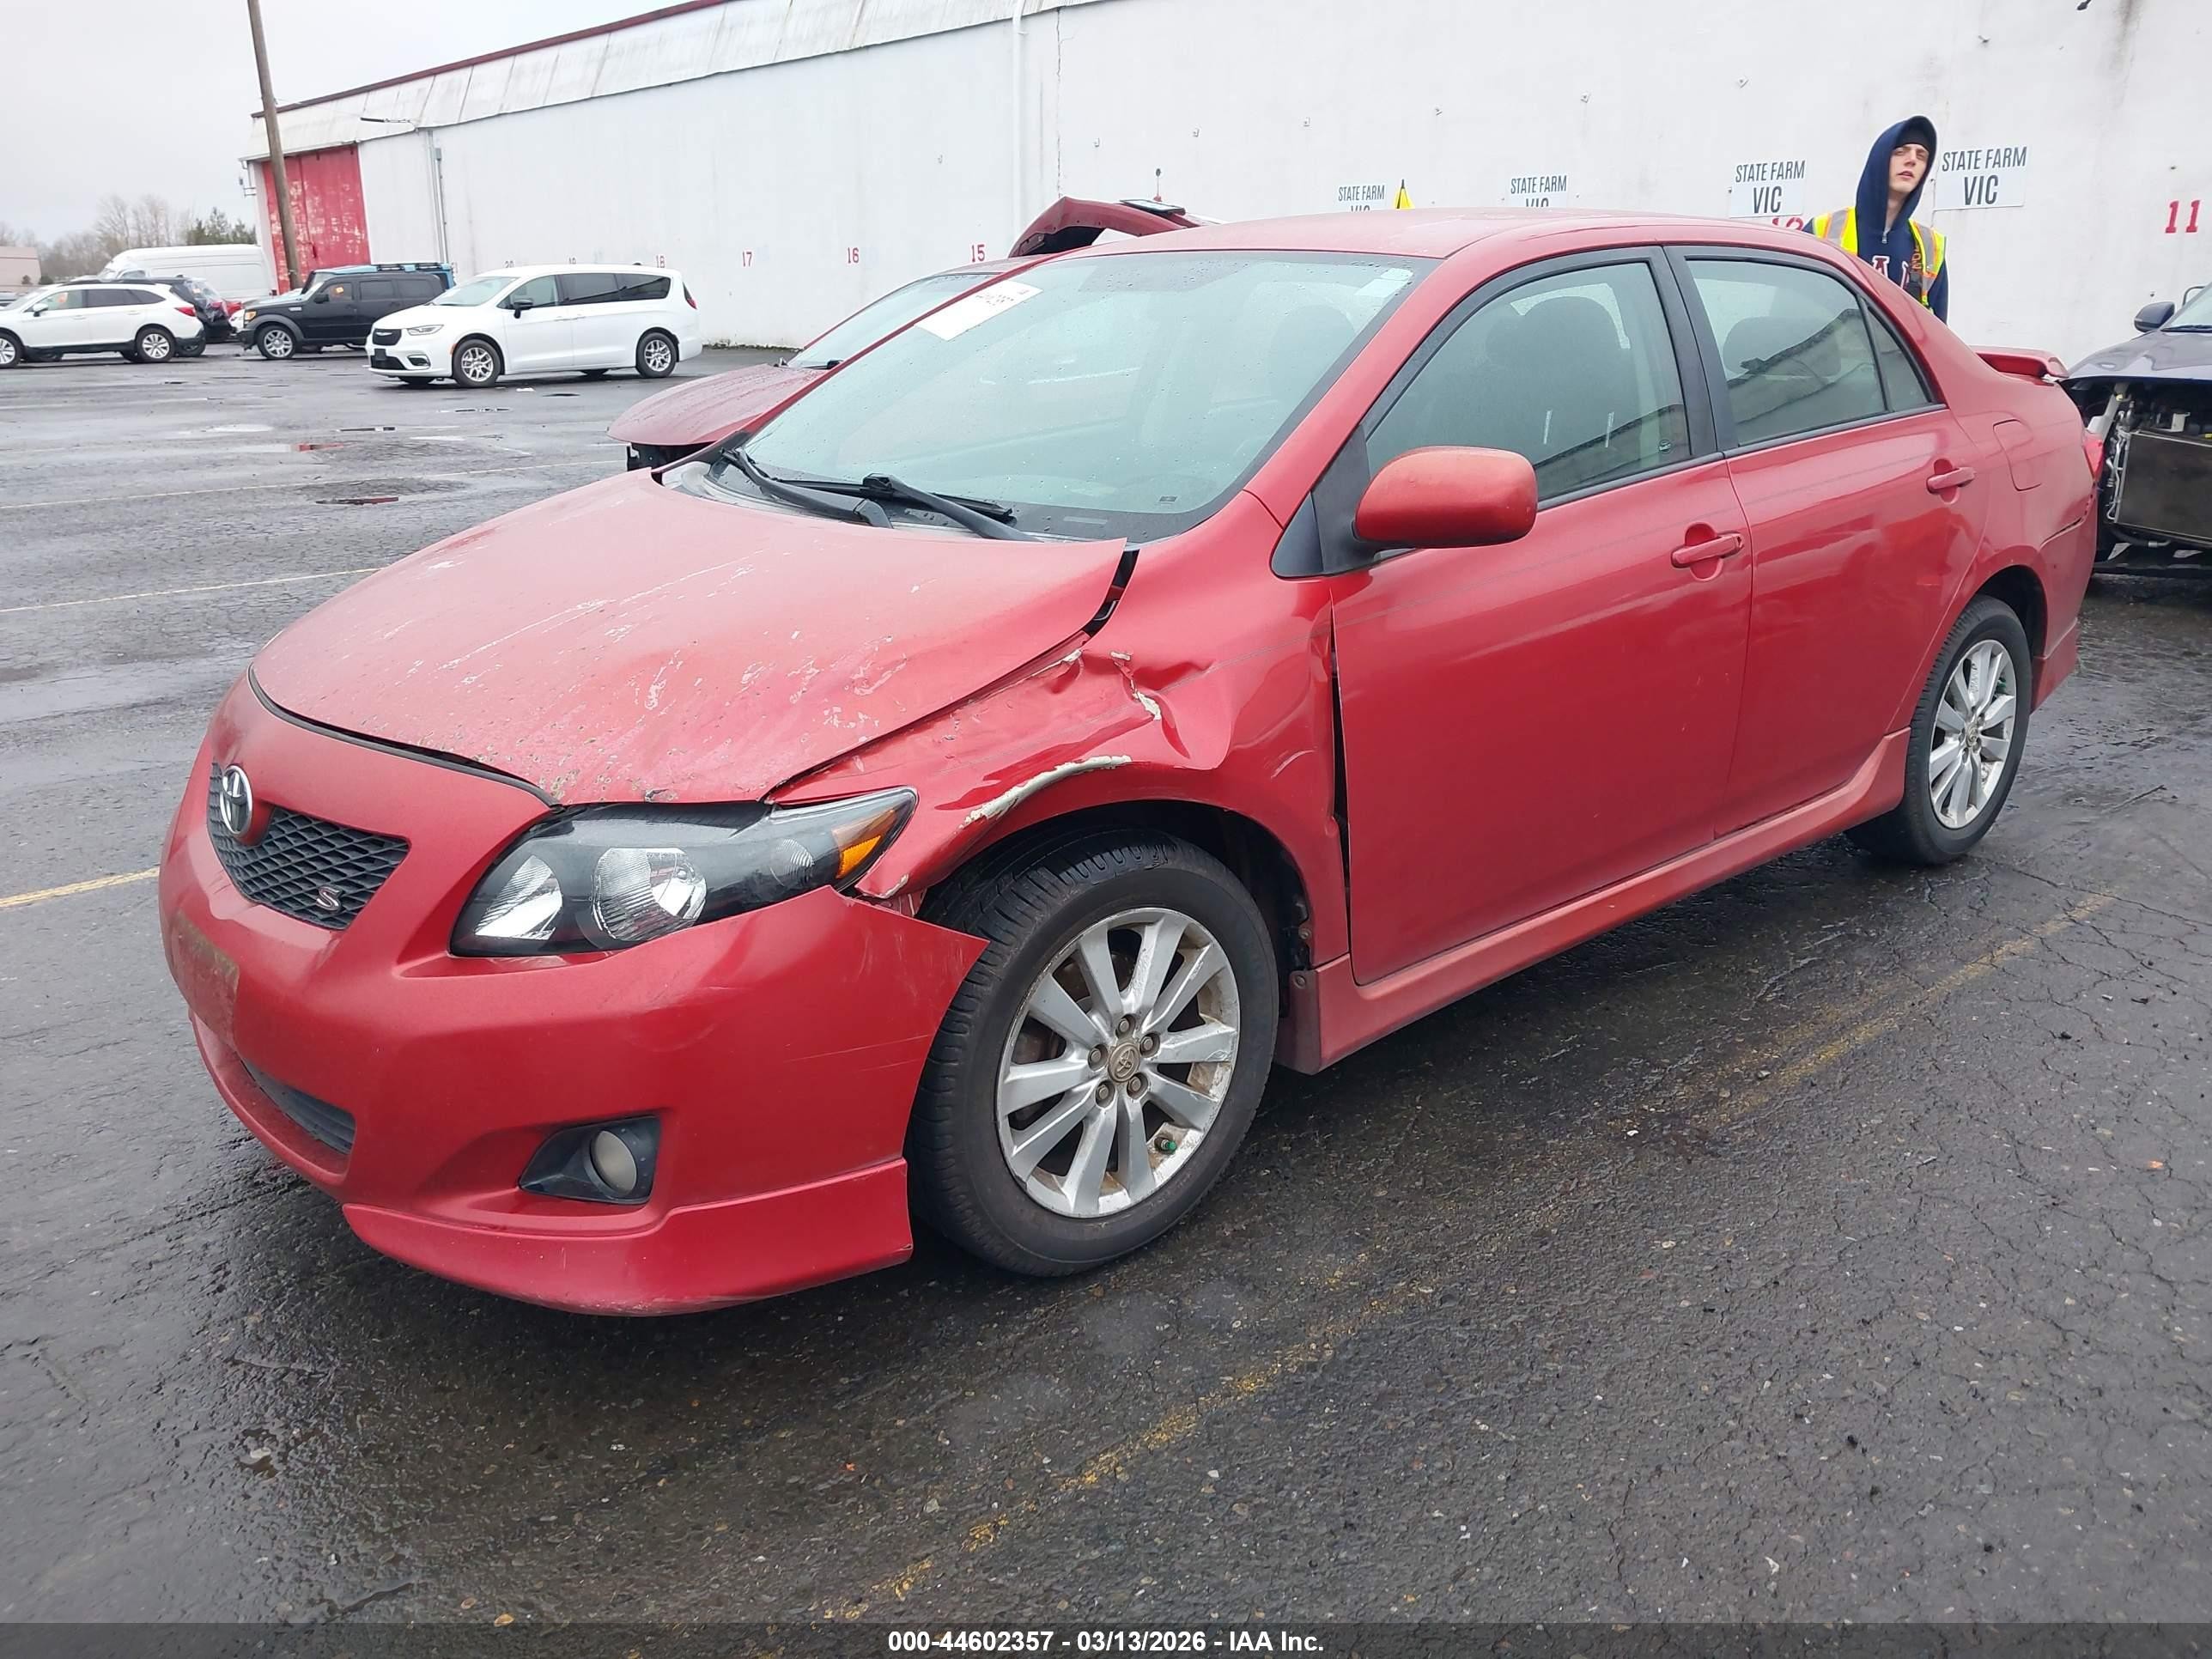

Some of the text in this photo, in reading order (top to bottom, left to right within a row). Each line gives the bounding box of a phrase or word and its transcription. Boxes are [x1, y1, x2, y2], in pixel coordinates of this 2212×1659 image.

[1942, 146, 2027, 172] STATE FARM
[1735, 160, 1805, 183] STATE FARM
[1339, 185, 1385, 202] STATE FARM
[1510, 175, 1567, 194] STATE FARM
[1964, 174, 1999, 205] VIC
[1753, 185, 1782, 214] VIC
[2165, 199, 2201, 234] 11
[655, 255, 665, 269] 18
[742, 251, 753, 267] 17
[848, 246, 860, 264] 16
[971, 244, 986, 263] 15
[316, 885, 341, 912] S
